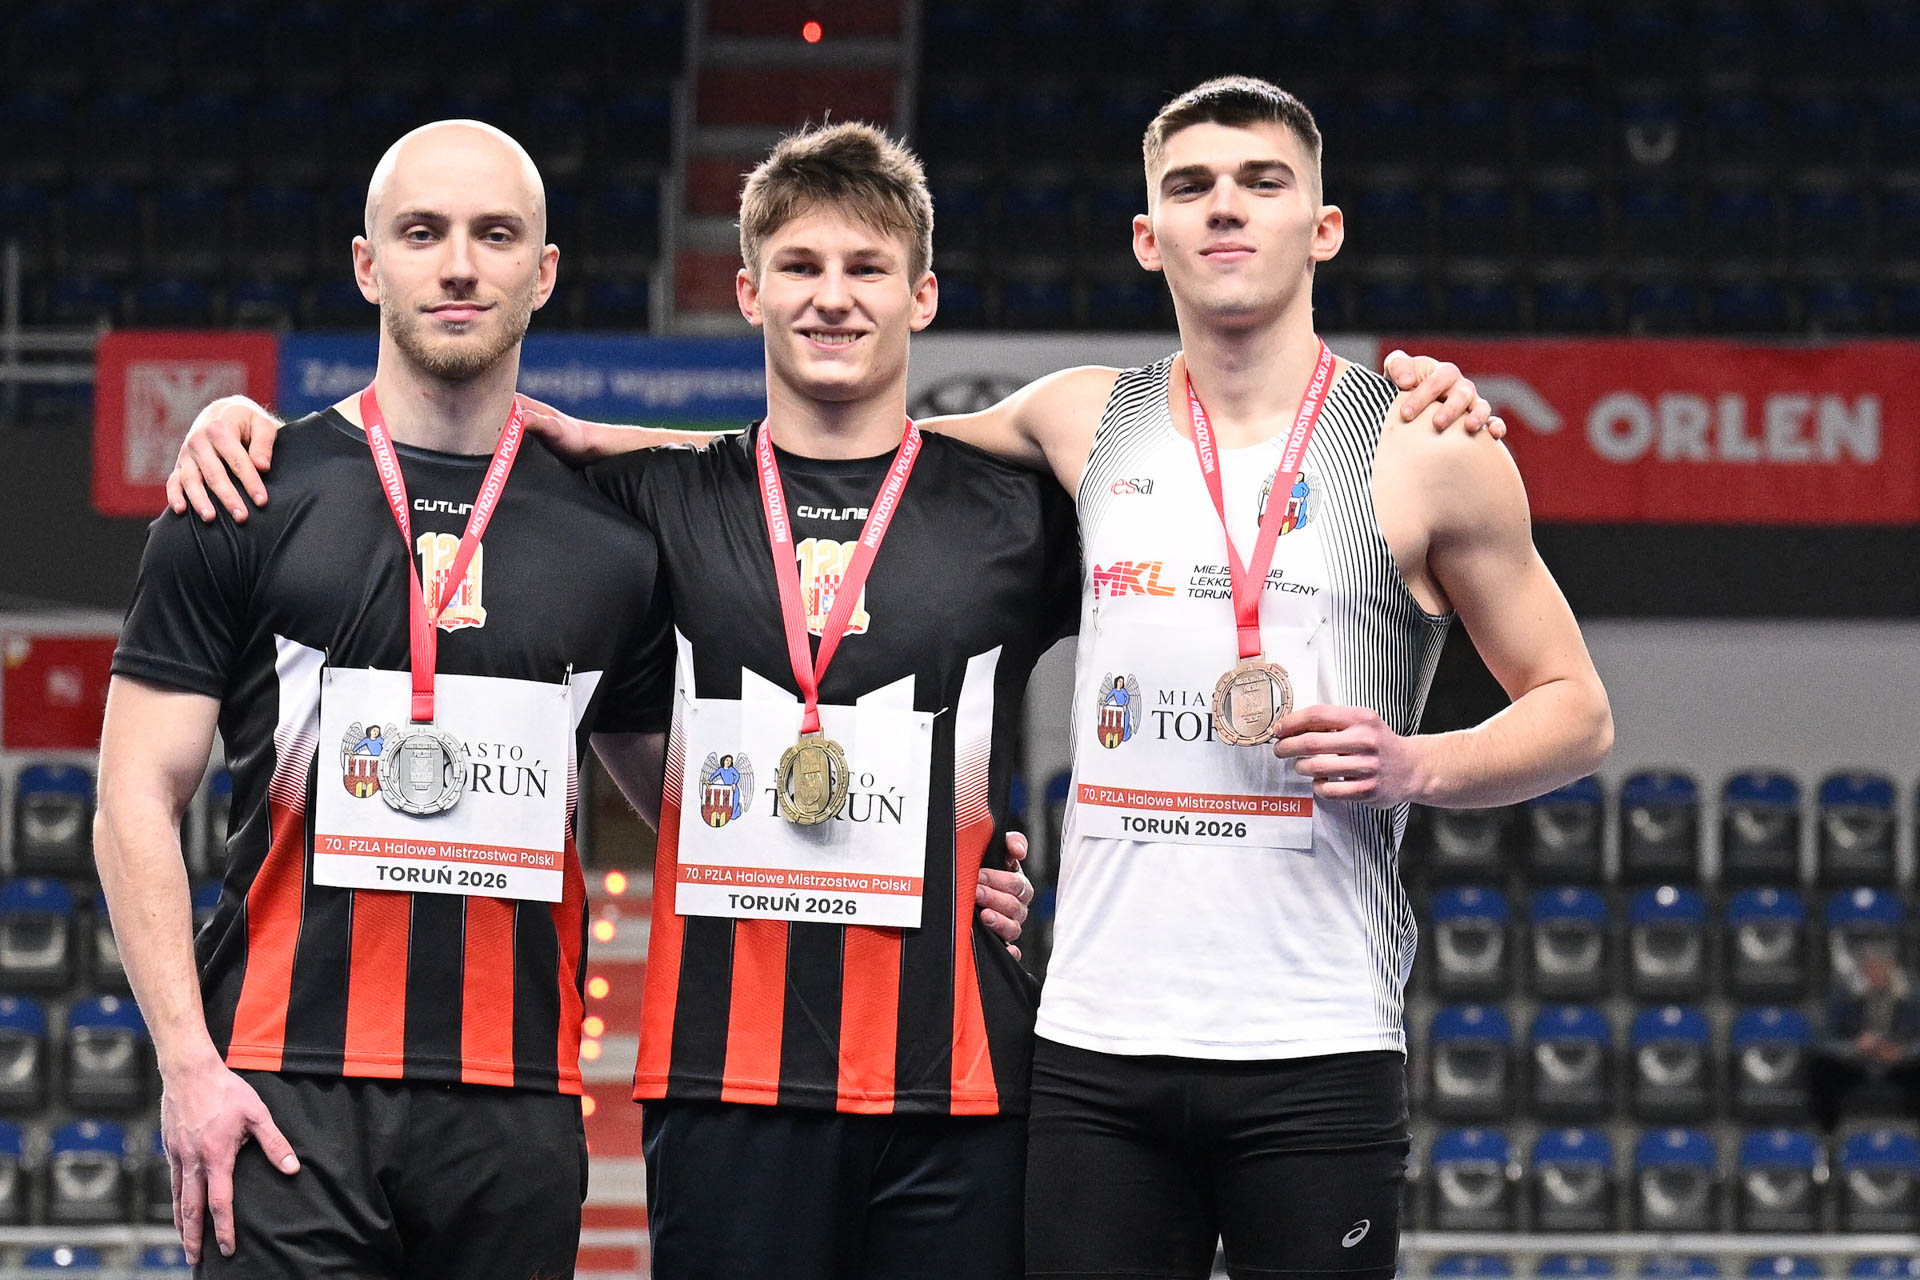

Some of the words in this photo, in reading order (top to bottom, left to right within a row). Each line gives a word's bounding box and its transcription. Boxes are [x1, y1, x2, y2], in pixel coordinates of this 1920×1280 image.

[1281, 400, 1316, 473] MISTRZOSTWA
[1308, 365, 1328, 400] POLSKI
[1587, 391, 1881, 463] ORLEN
[369, 424, 402, 504] MISTRZOSTWA
[470, 459, 507, 538] MISTRZOSTWA
[501, 418, 521, 459] POLSKI
[414, 498, 474, 515] CUTLIN
[763, 467, 787, 543] MISTRZOSTWA
[864, 474, 902, 548] MISTRZOSTWA
[896, 439, 916, 476] POLSKI
[797, 505, 869, 520] CUTLINE
[1094, 561, 1176, 600] MKL
[1193, 564, 1231, 576] MIEJS
[460, 742, 523, 761] ASTO
[1083, 788, 1098, 801] 70.
[1100, 791, 1125, 804] PZLA
[1128, 793, 1174, 807] Halowe
[1177, 795, 1257, 812] Mistrzostwa
[1262, 800, 1301, 813] Polski
[1121, 815, 1190, 835] TORUŃ
[1195, 820, 1247, 838] 2026
[325, 838, 345, 851] 70.
[350, 840, 381, 853] PZLA
[385, 842, 437, 856] Halowe
[440, 845, 518, 863] Mistrzostwa
[520, 851, 555, 867] Polski
[376, 865, 452, 885] TORUŃ
[457, 871, 508, 890] 2026
[685, 867, 702, 880] 70.
[705, 869, 733, 882] PZLA
[736, 870, 785, 884] Halowe
[788, 872, 868, 890] Mistrzostwa
[872, 878, 912, 893] Polski
[728, 893, 800, 913] TORUŃ
[805, 897, 857, 916] 2026
